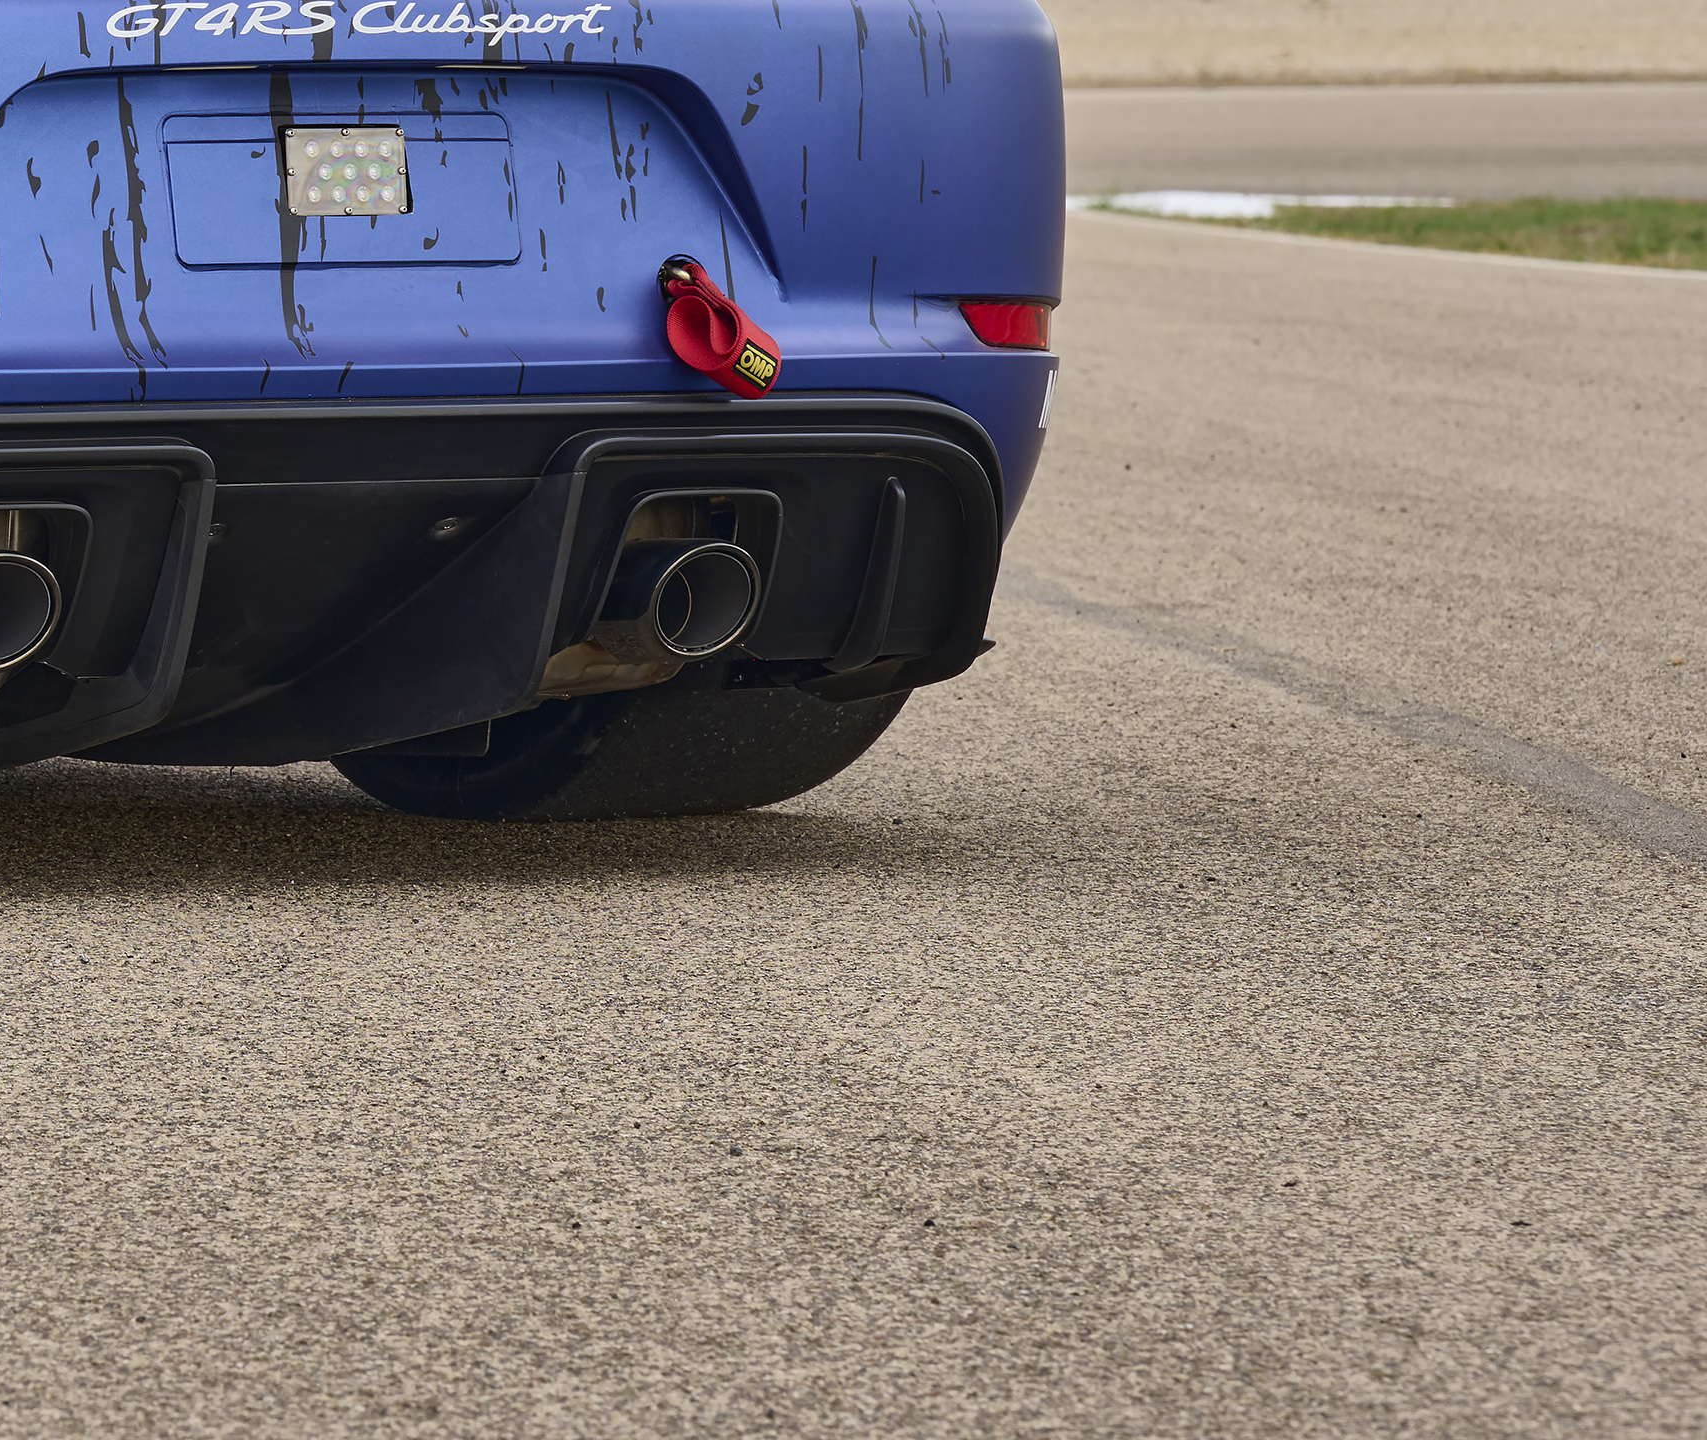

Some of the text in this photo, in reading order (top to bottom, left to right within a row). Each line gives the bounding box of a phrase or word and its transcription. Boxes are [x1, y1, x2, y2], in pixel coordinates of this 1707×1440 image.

[105, 0, 613, 47] GT4RS Clubsport
[740, 350, 775, 380] OMP
